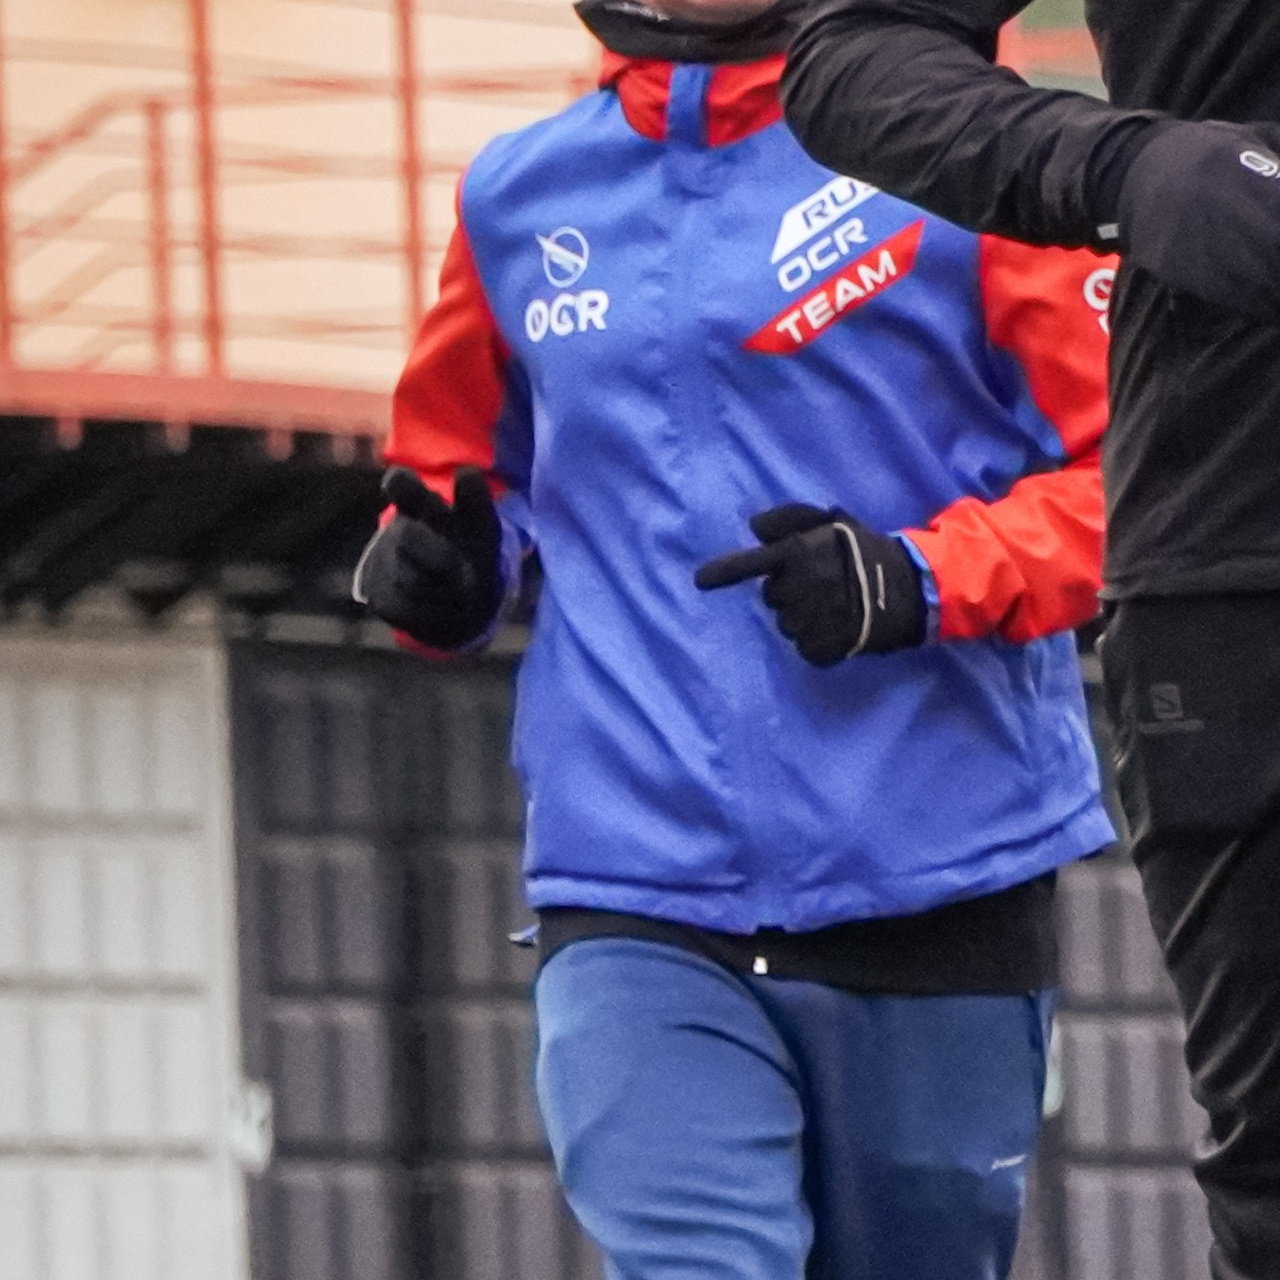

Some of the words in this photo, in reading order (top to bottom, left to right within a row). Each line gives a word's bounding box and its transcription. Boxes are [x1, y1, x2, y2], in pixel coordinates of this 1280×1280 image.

[777, 217, 869, 293] OCR
[525, 289, 610, 342] OCR
[776, 249, 898, 343] TEAM
